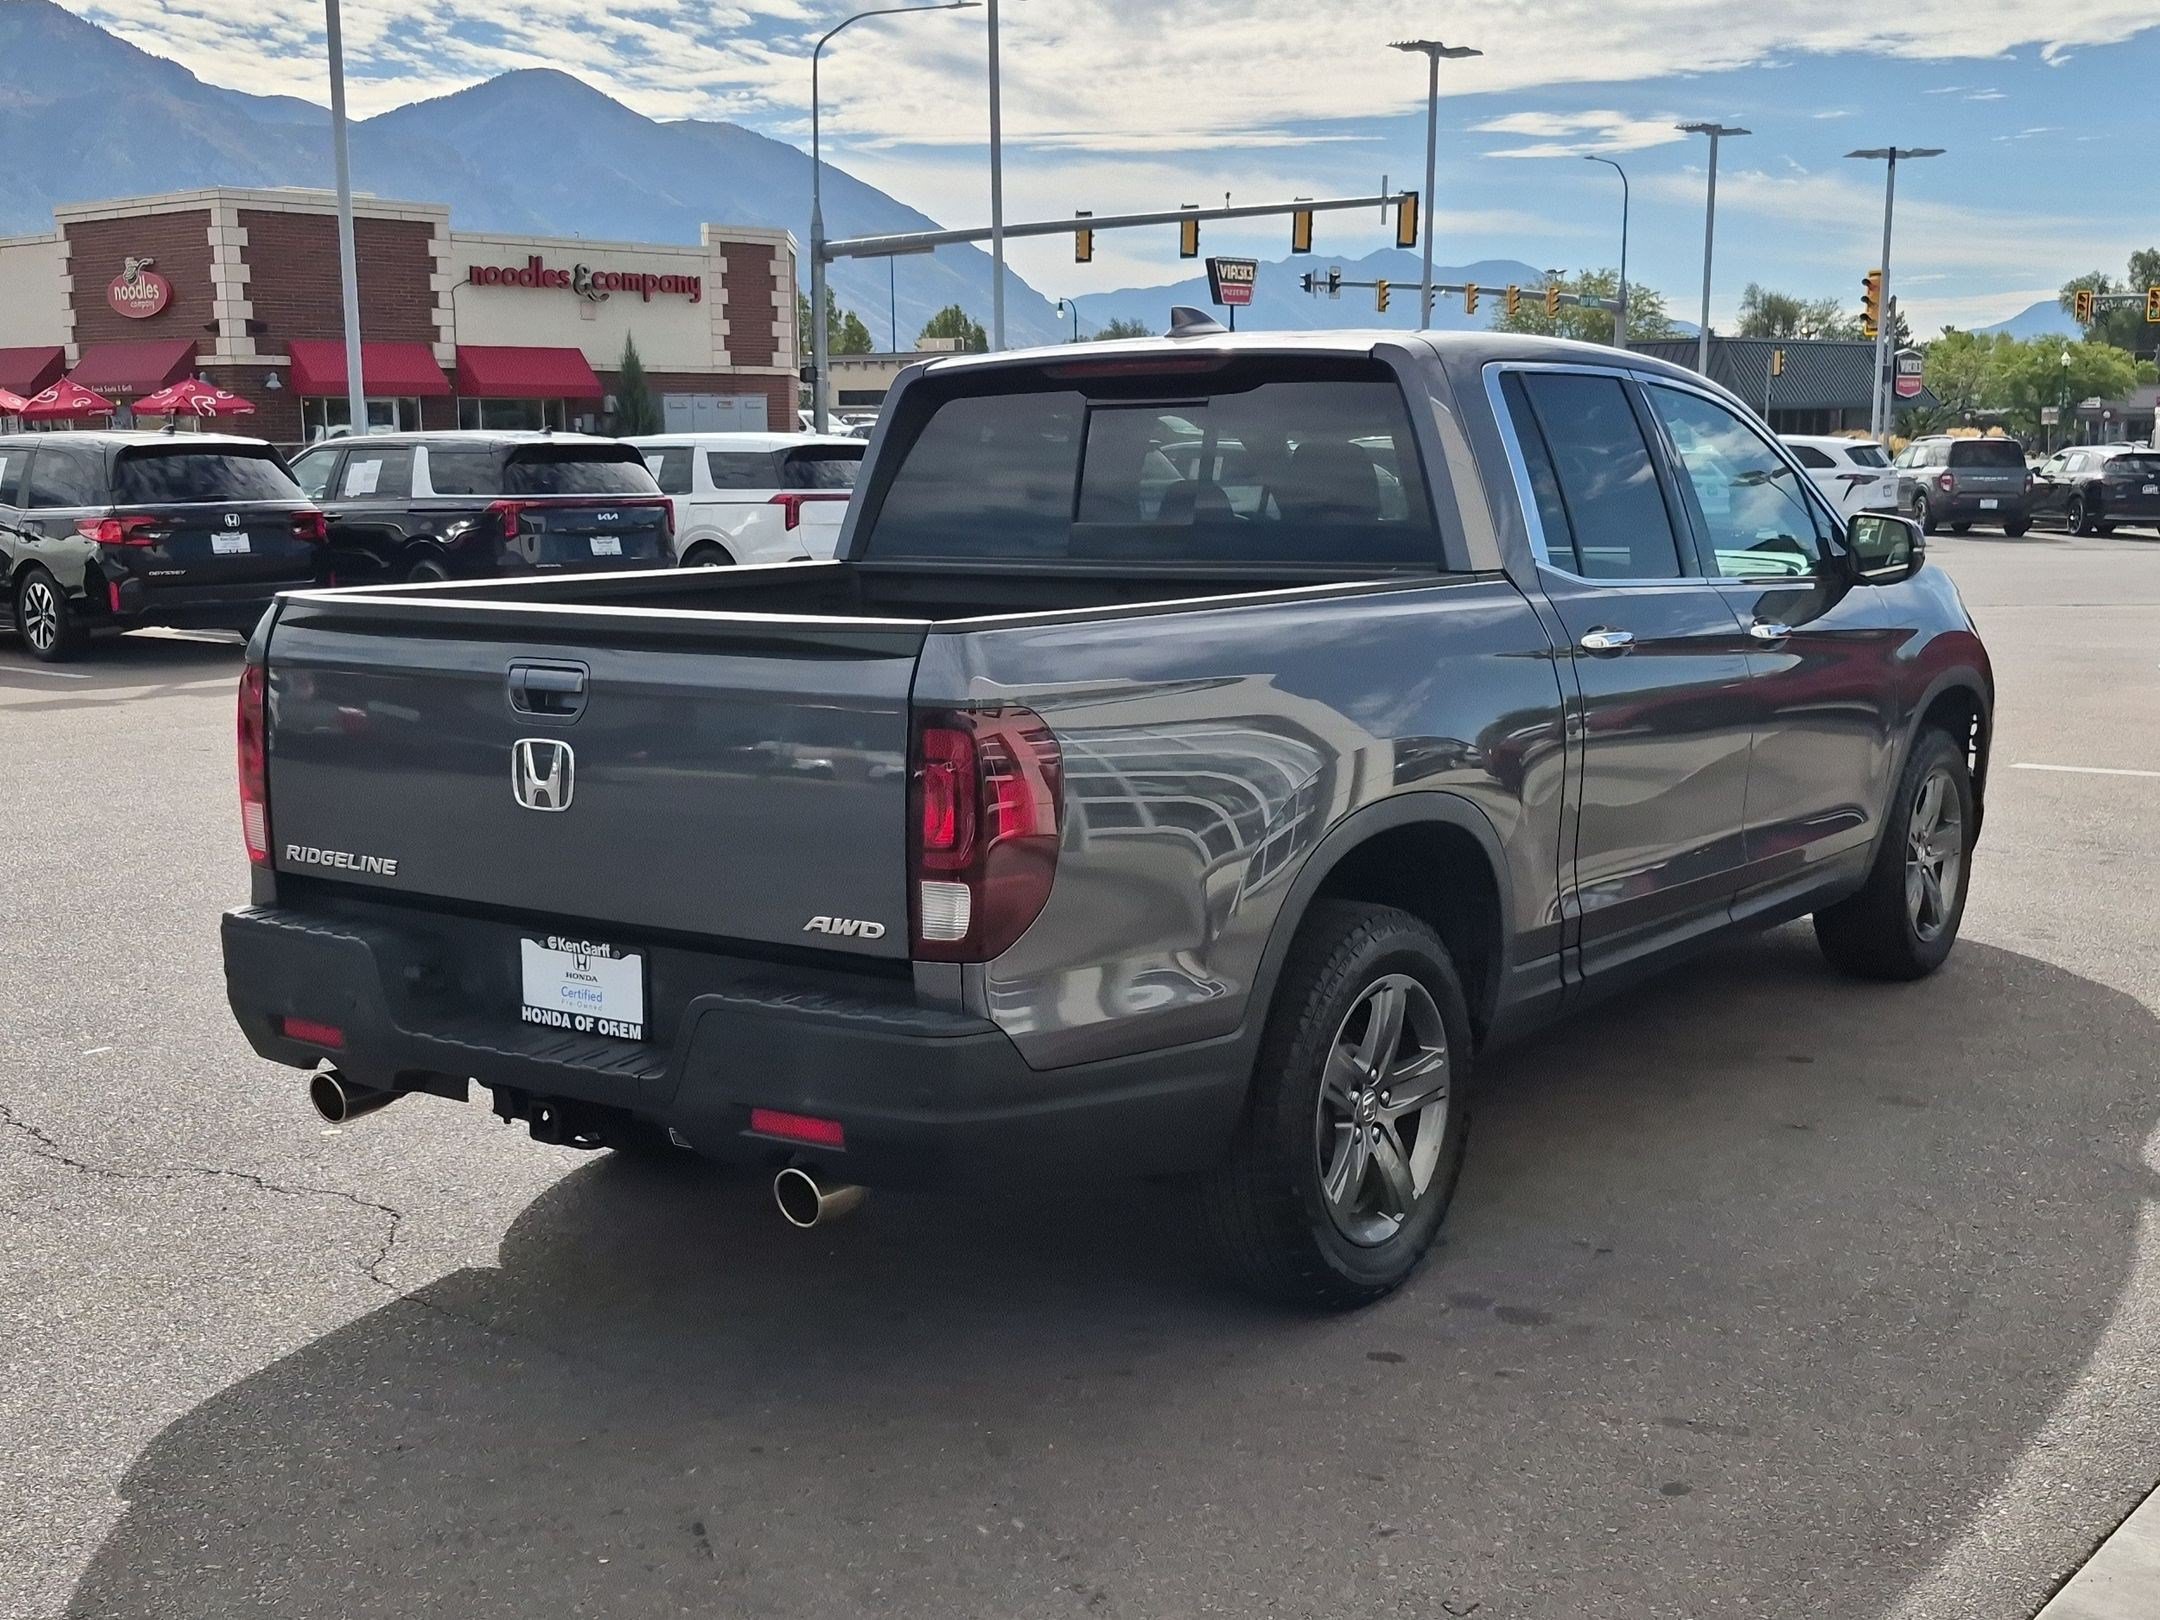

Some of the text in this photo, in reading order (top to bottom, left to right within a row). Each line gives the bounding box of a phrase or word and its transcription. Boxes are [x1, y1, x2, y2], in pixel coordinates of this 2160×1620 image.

[114, 274, 160, 301] noodles
[469, 255, 571, 289] noodles
[591, 271, 701, 303] company
[286, 844, 399, 876] RIDGELINE
[802, 915, 886, 940] AWD
[565, 971, 599, 983] HONDA
[561, 986, 603, 1003] Certified
[521, 1005, 642, 1040] HONDA OF OREM
